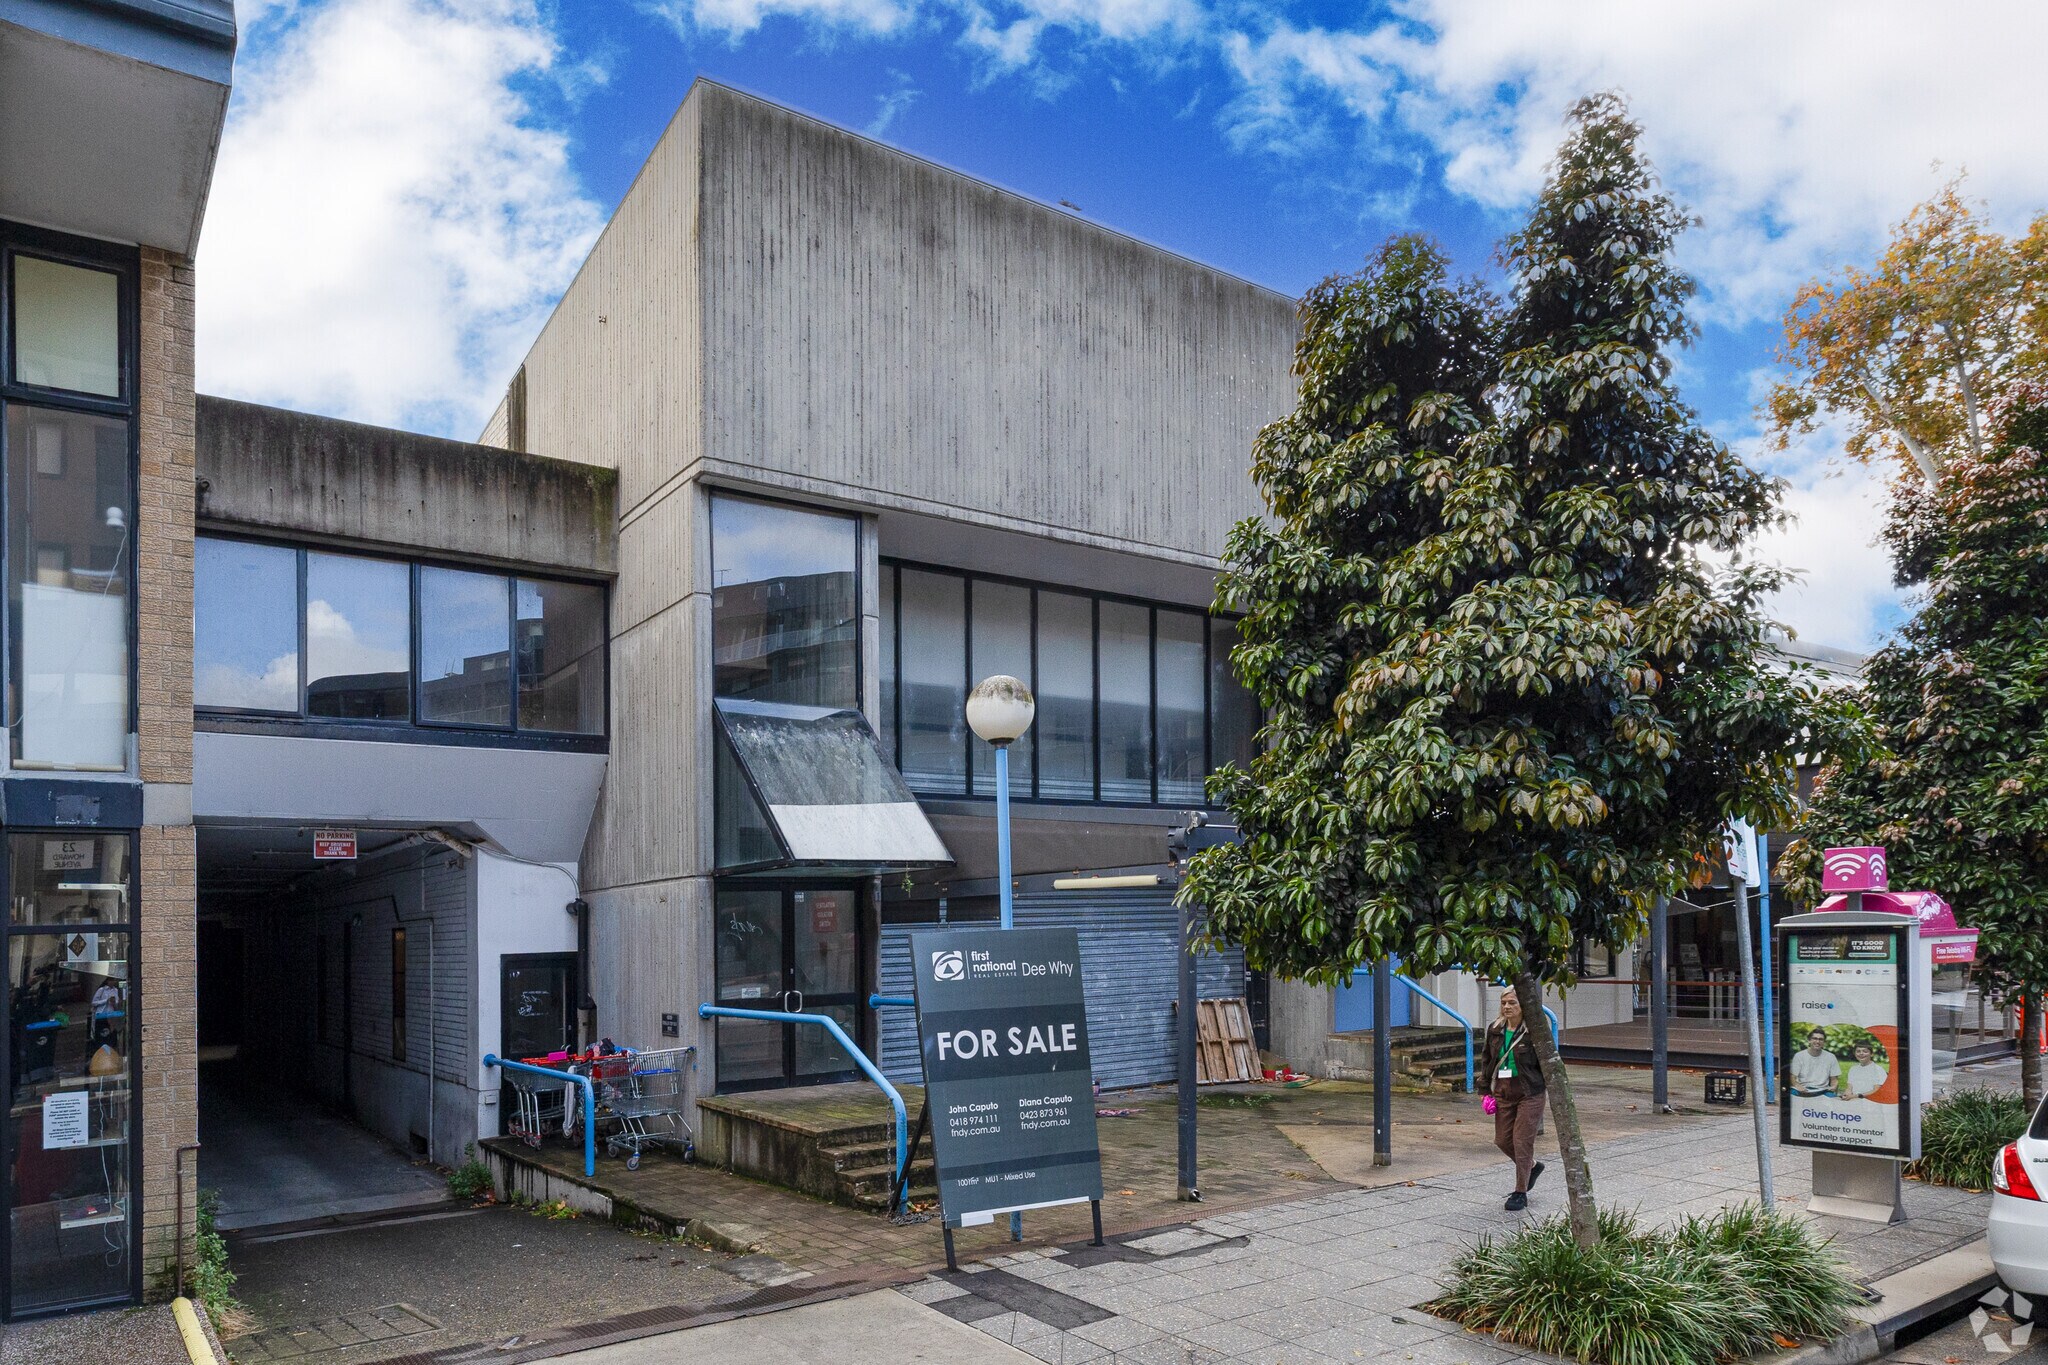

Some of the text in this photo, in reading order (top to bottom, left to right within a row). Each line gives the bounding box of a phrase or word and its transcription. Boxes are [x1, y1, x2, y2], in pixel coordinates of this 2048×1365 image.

[316, 832, 354, 840] NO PARKING
[971, 951, 990, 961] first
[973, 960, 1016, 972] national
[1021, 960, 1073, 977] Dee Why
[1801, 1000, 1827, 1010] raise
[937, 1023, 1077, 1060] FOR SALE
[1019, 1094, 1073, 1107] Diana Caputo
[948, 1102, 999, 1114] John Caputo
[1019, 1107, 1068, 1120] 0423 873 961
[949, 1114, 998, 1127] 0418 974 111
[1802, 1108, 1861, 1124] Give hope
[1020, 1118, 1071, 1130] fndy.com.au
[1802, 1122, 1884, 1137] Volunteer to mentor
[951, 1125, 1001, 1138] fndy.com.au
[1802, 1131, 1873, 1145] and help support
[1004, 1172, 1024, 1181] Mixed
[1024, 1171, 1036, 1179] Use
